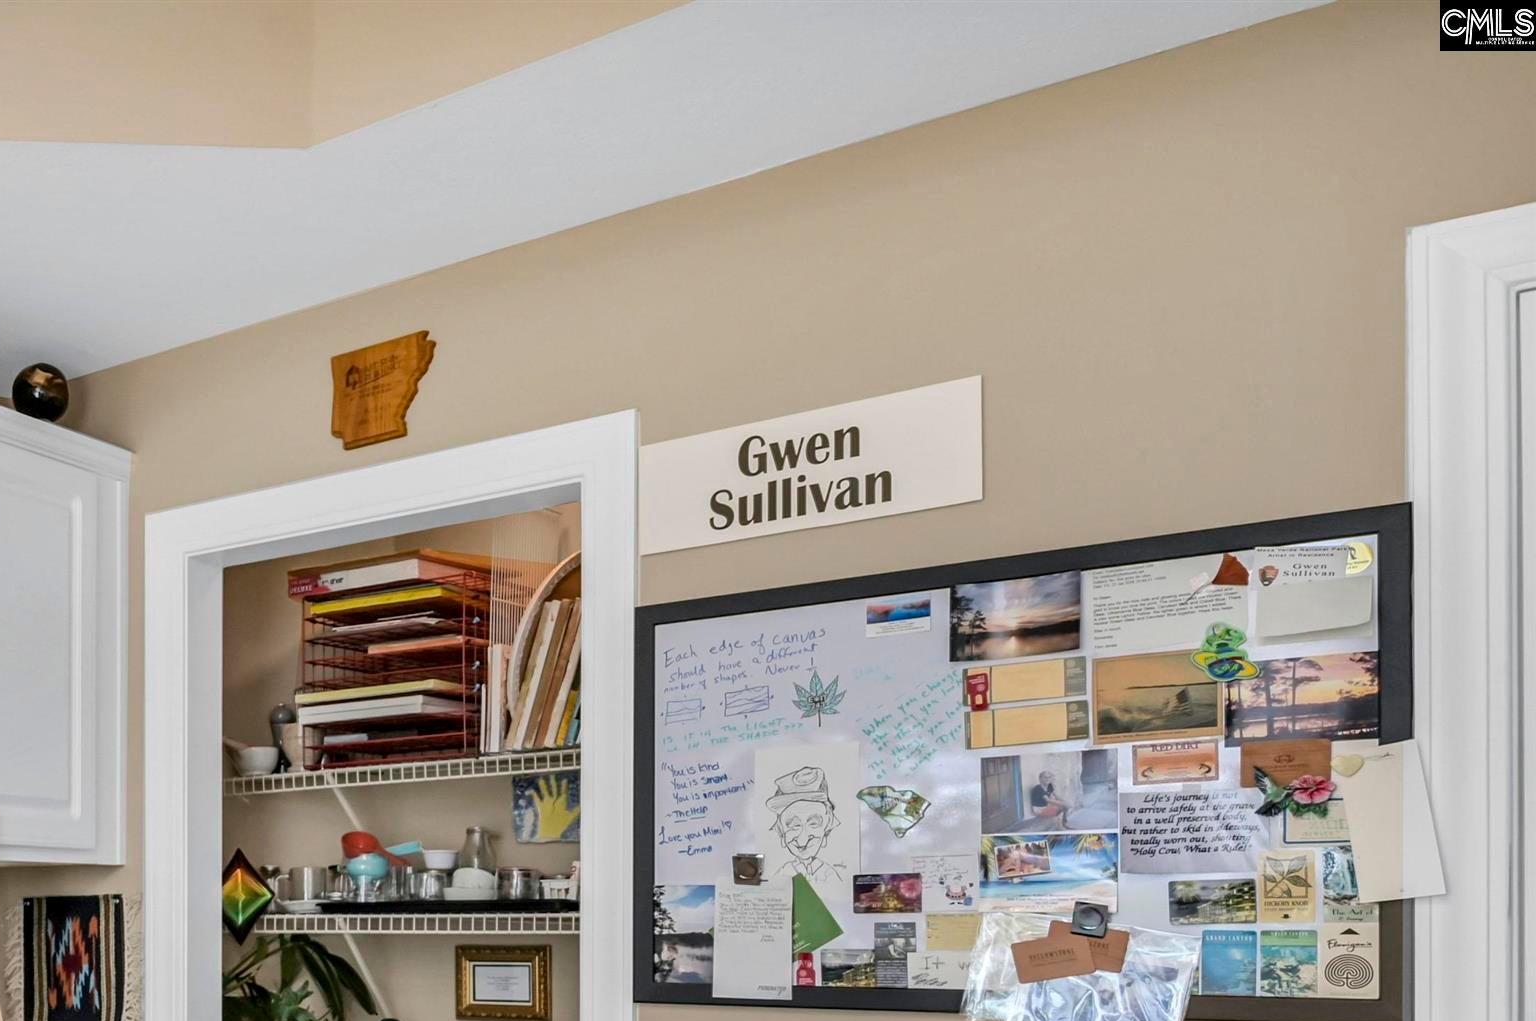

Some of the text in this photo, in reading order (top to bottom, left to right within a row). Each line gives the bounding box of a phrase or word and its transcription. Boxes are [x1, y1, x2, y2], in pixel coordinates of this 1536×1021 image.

[737, 425, 861, 477] Gwen
[709, 470, 892, 530] Sullivan
[664, 627, 826, 668] Each edge of canvas
[668, 664, 706, 683] should
[718, 660, 742, 672] have
[766, 644, 818, 663] different
[765, 665, 800, 676] Never
[746, 717, 785, 731] LIGHT
[1151, 744, 1173, 752] RED
[1176, 742, 1199, 750] DIRT
[698, 762, 720, 772] kind
[671, 773, 728, 790] You is smart
[673, 792, 700, 804] You is
[1144, 793, 1170, 805] Life's
[1173, 794, 1209, 805] journey
[1127, 806, 1136, 814] to
[1138, 806, 1166, 814] arrive
[1169, 803, 1196, 815] safely
[1213, 803, 1227, 811] the
[1228, 803, 1255, 813] grave
[1154, 814, 1174, 824] well
[1176, 814, 1219, 825] preserved
[1122, 827, 1136, 835] but
[1139, 827, 1168, 835] rather
[1182, 823, 1201, 833] skid
[659, 826, 701, 845] Love you
[1131, 837, 1161, 847] totally
[1189, 835, 1208, 843] out,
[1184, 844, 1211, 853] What
